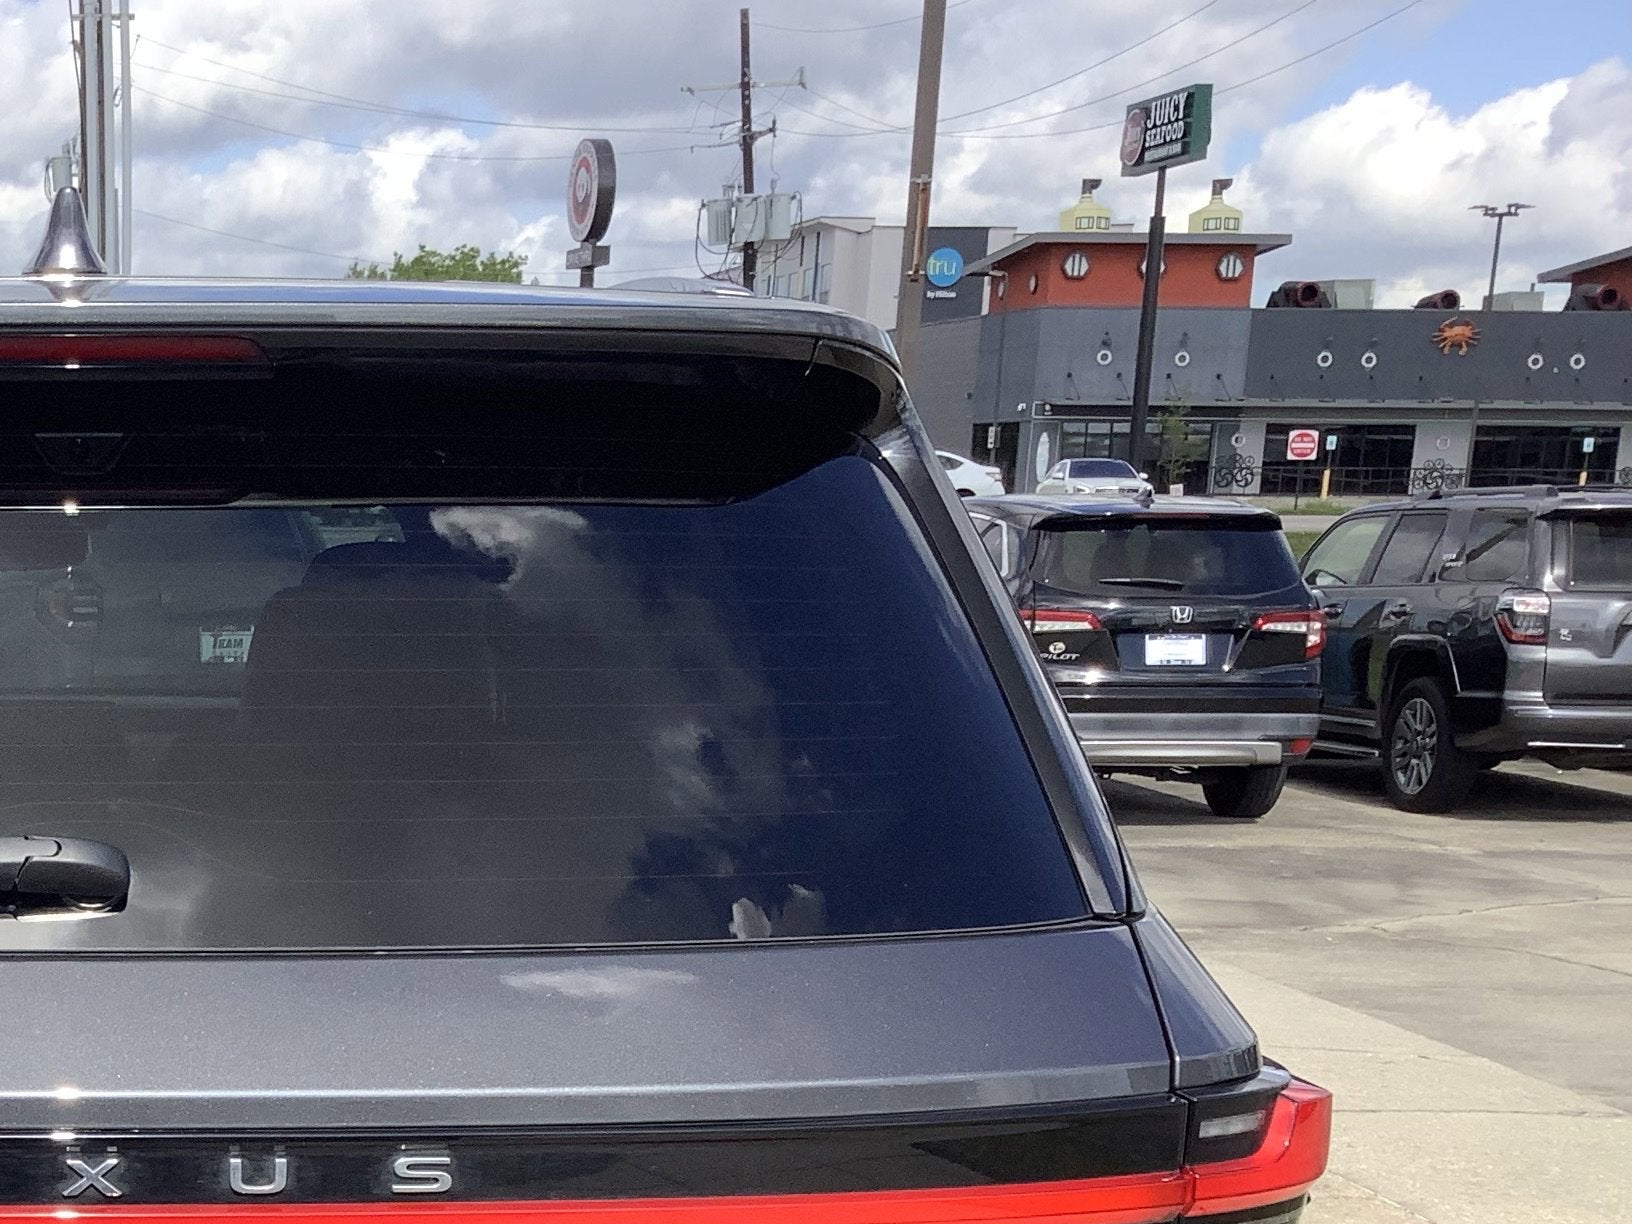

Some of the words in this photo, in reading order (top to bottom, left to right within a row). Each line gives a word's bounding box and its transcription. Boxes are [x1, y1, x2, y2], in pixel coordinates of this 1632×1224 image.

[1146, 92, 1188, 129] JUICY
[1145, 120, 1185, 148] SEAFOOD
[928, 256, 957, 276] tru
[1039, 652, 1081, 661] PILOT
